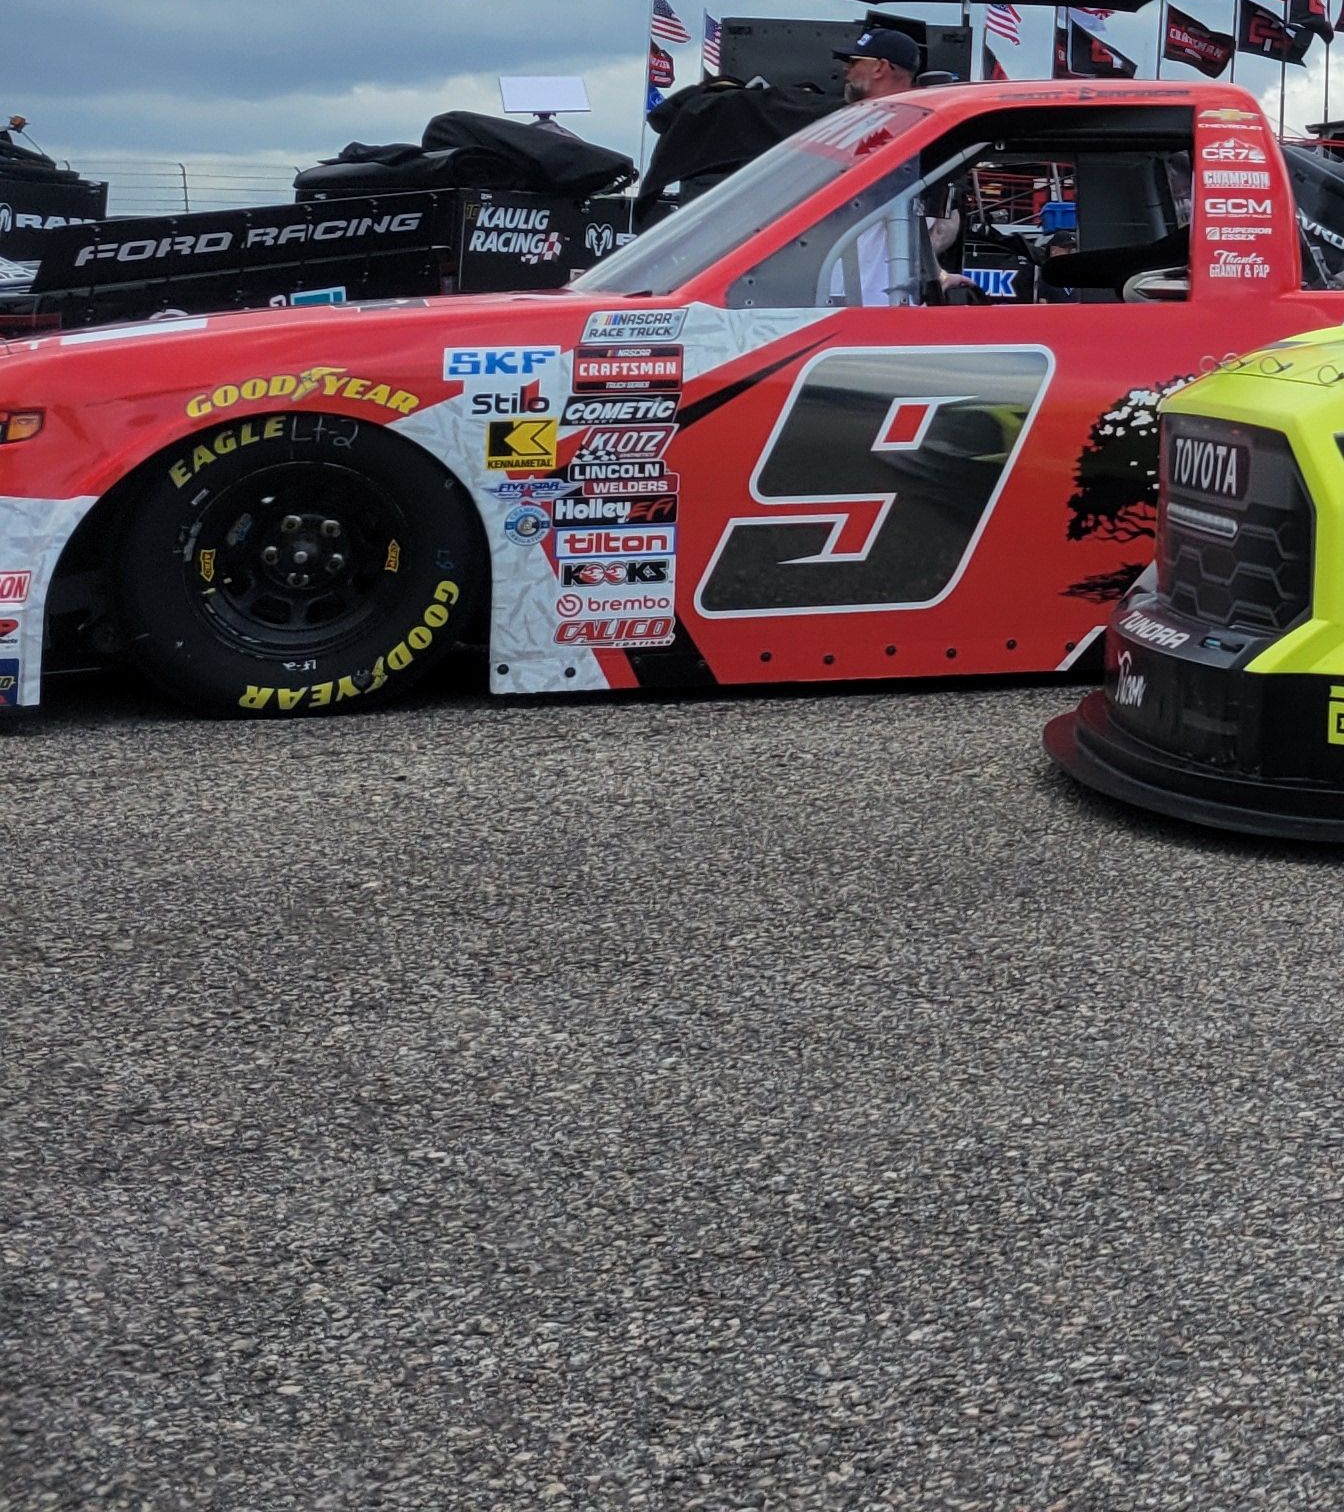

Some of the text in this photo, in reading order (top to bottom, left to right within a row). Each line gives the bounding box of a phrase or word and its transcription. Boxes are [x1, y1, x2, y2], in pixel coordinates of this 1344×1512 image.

[1202, 148, 1250, 161] CR7
[1203, 171, 1270, 185] CHAMPION
[1205, 198, 1272, 214] GCM
[476, 206, 550, 231] KAULIG
[74, 212, 424, 267] FORD RACING
[469, 230, 546, 254] RACING
[1221, 227, 1272, 235] SUPERIOR
[1214, 249, 1264, 264] Thanks
[1209, 264, 1270, 278] GRANNY & PAP
[617, 313, 672, 326] NASCAR
[589, 326, 674, 338] RACE TRUCK
[448, 350, 556, 376] SKF
[617, 348, 651, 357] NASCAR
[579, 361, 678, 377] CRAFTSMAN
[186, 366, 420, 418] GOODYEAR
[565, 399, 677, 421] COMETIC
[168, 416, 288, 488] EAGLE
[589, 430, 667, 454] KLOTZ
[487, 458, 553, 470] KENNAMETAL
[574, 464, 660, 480] LINCOLN
[1174, 438, 1237, 496] TOYOTA
[593, 481, 669, 494] WELDERS
[693, 344, 1056, 619] 9
[555, 497, 675, 524] Holley EFI
[564, 532, 668, 554] tilton
[562, 561, 669, 586] KOOKS
[588, 595, 670, 612] brembo
[555, 617, 675, 642] CALICO
[1119, 610, 1190, 649] TUNDRA
[238, 580, 460, 710] GOODYEAR
